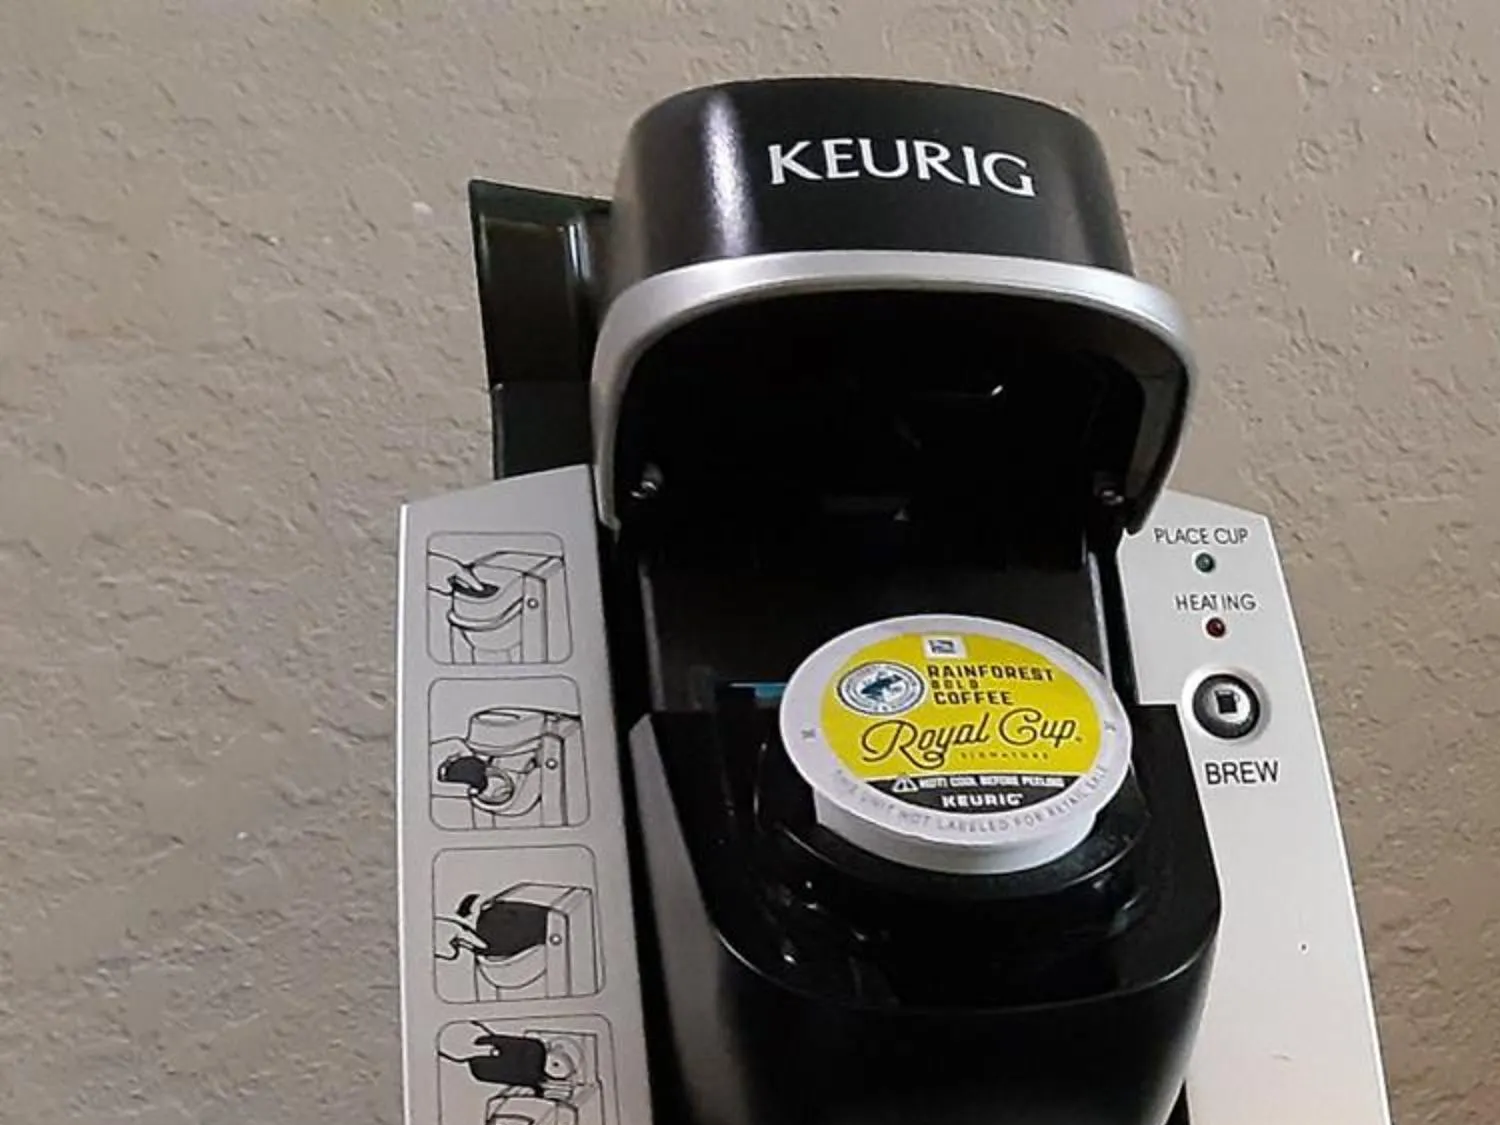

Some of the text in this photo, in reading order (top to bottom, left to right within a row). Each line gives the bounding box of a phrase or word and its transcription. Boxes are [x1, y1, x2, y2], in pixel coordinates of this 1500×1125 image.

[768, 138, 1037, 197] KEURIG
[1154, 527, 1249, 545] PLACE CUP
[1175, 593, 1257, 611] HEATING
[927, 664, 1054, 682] RAINFOREST
[934, 691, 1014, 706] COFFEE
[861, 712, 991, 770] Royal
[1204, 760, 1279, 786] BREW
[940, 793, 1024, 808] KEURIG
